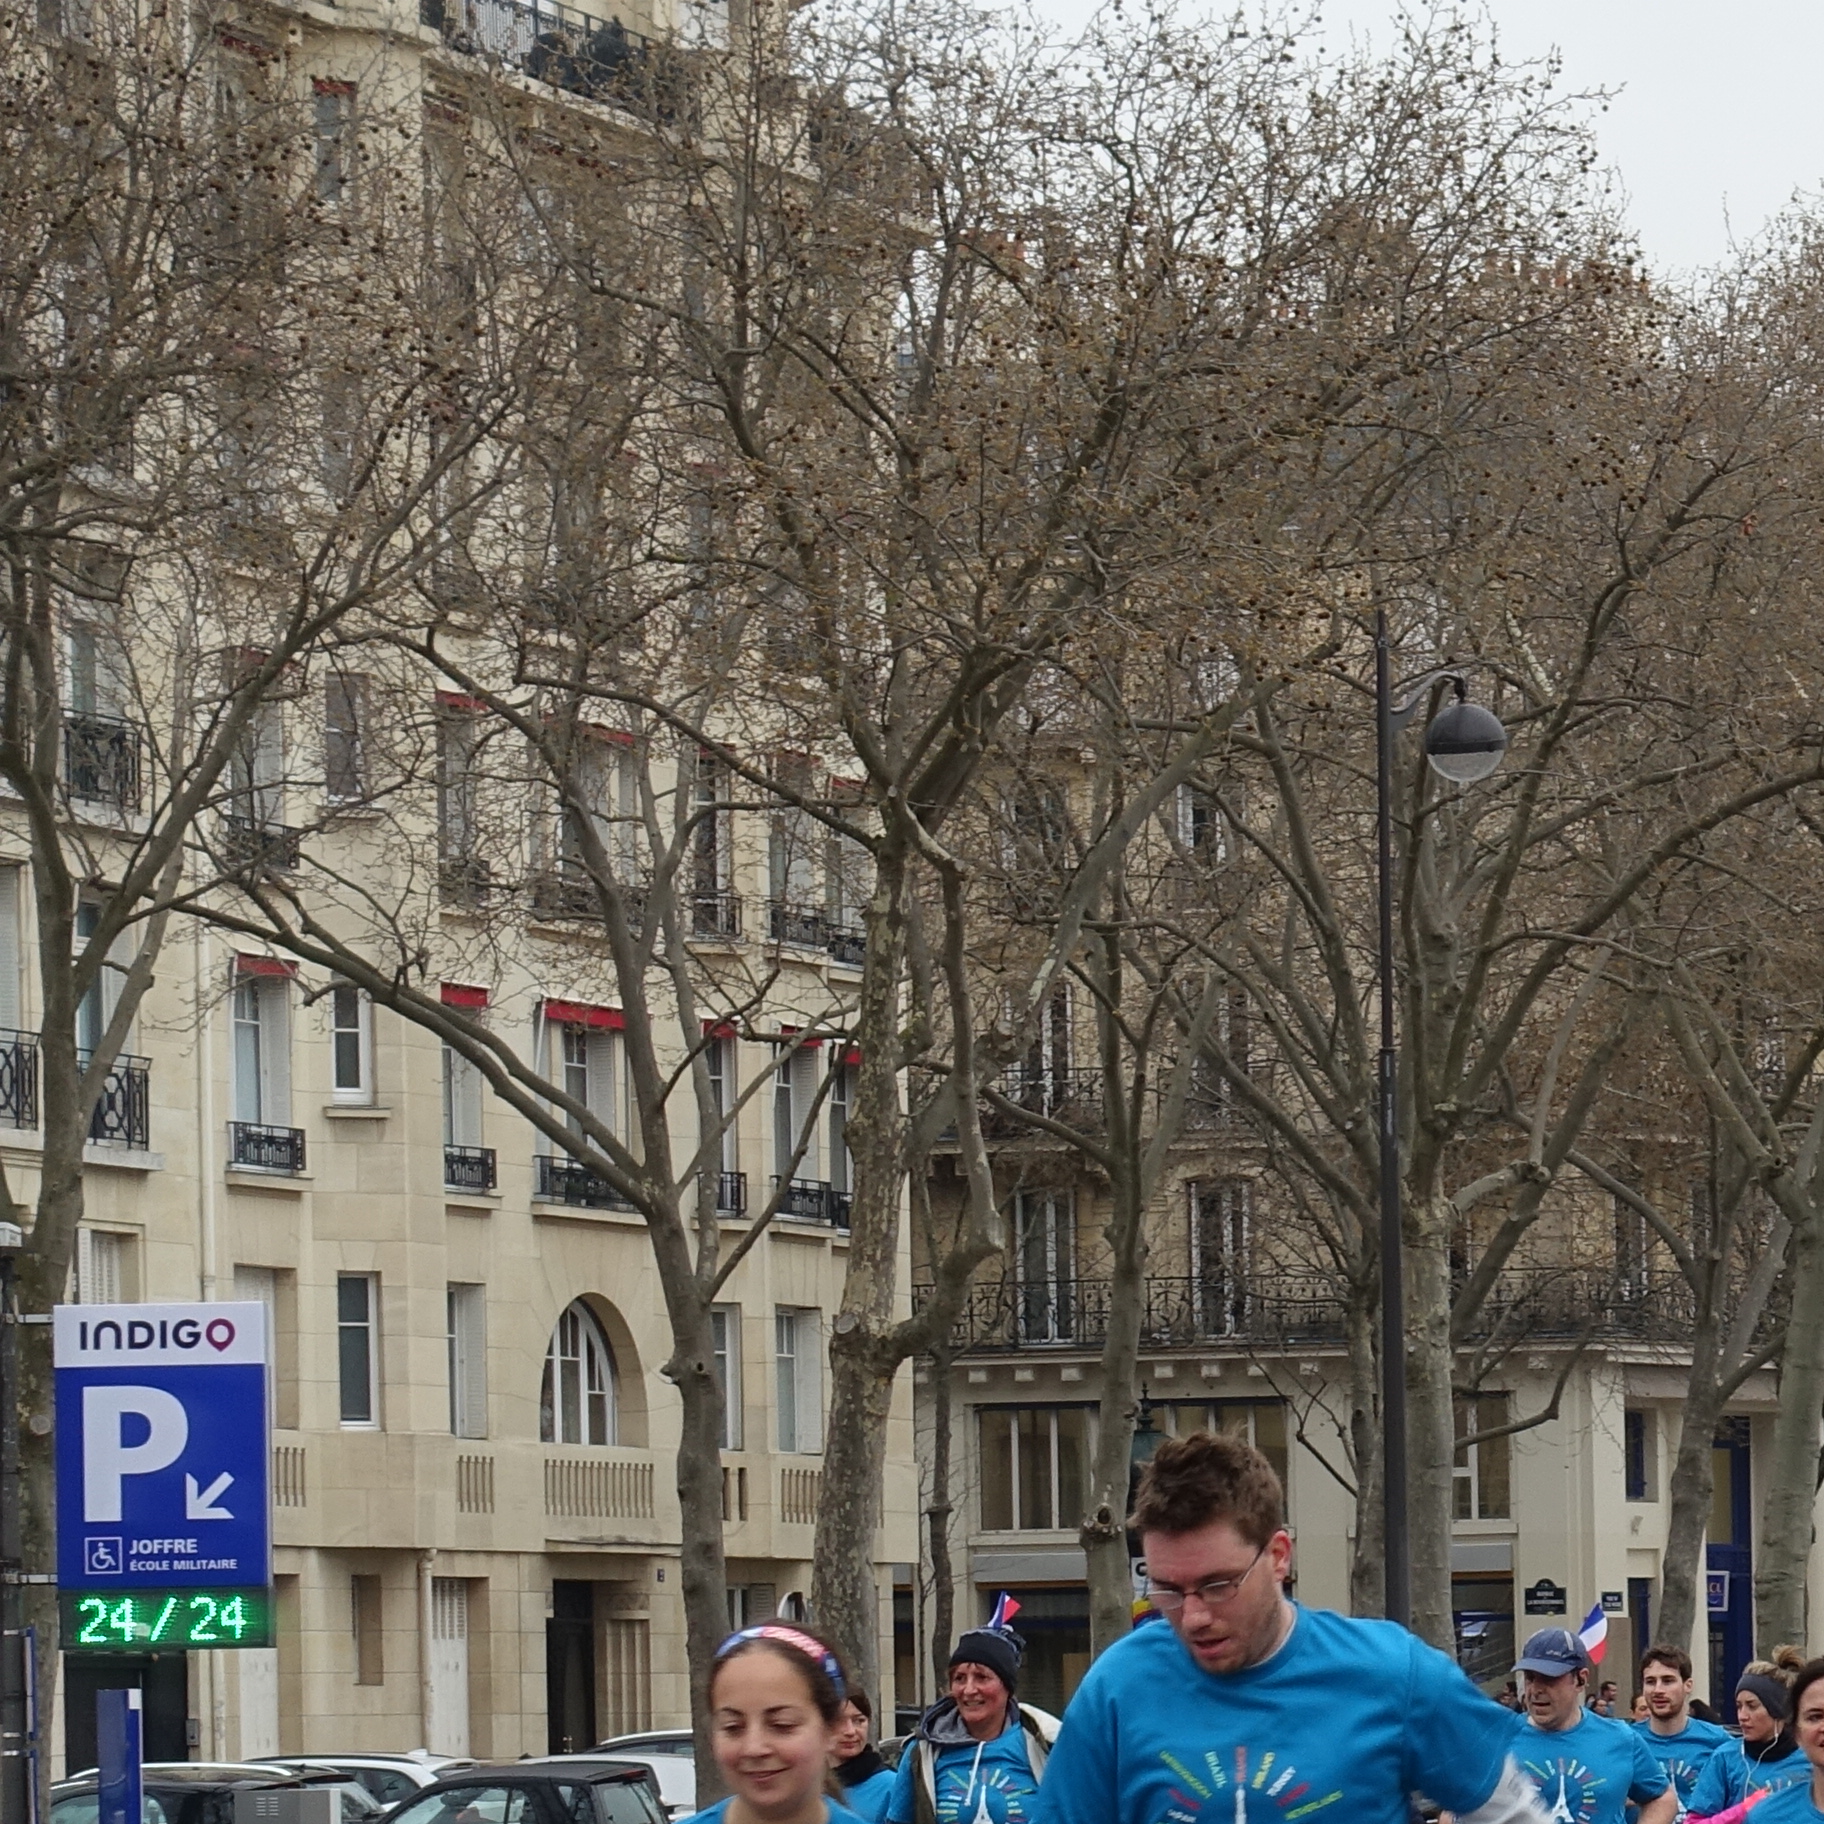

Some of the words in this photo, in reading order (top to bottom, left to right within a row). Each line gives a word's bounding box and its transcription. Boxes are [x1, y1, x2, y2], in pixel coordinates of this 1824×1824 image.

[80, 1318, 236, 1352] INDIGO
[83, 1385, 189, 1523] P
[129, 1539, 198, 1555] JOFFRE
[130, 1559, 170, 1571] ÉCOLE
[173, 1559, 238, 1571] MILITAIRE
